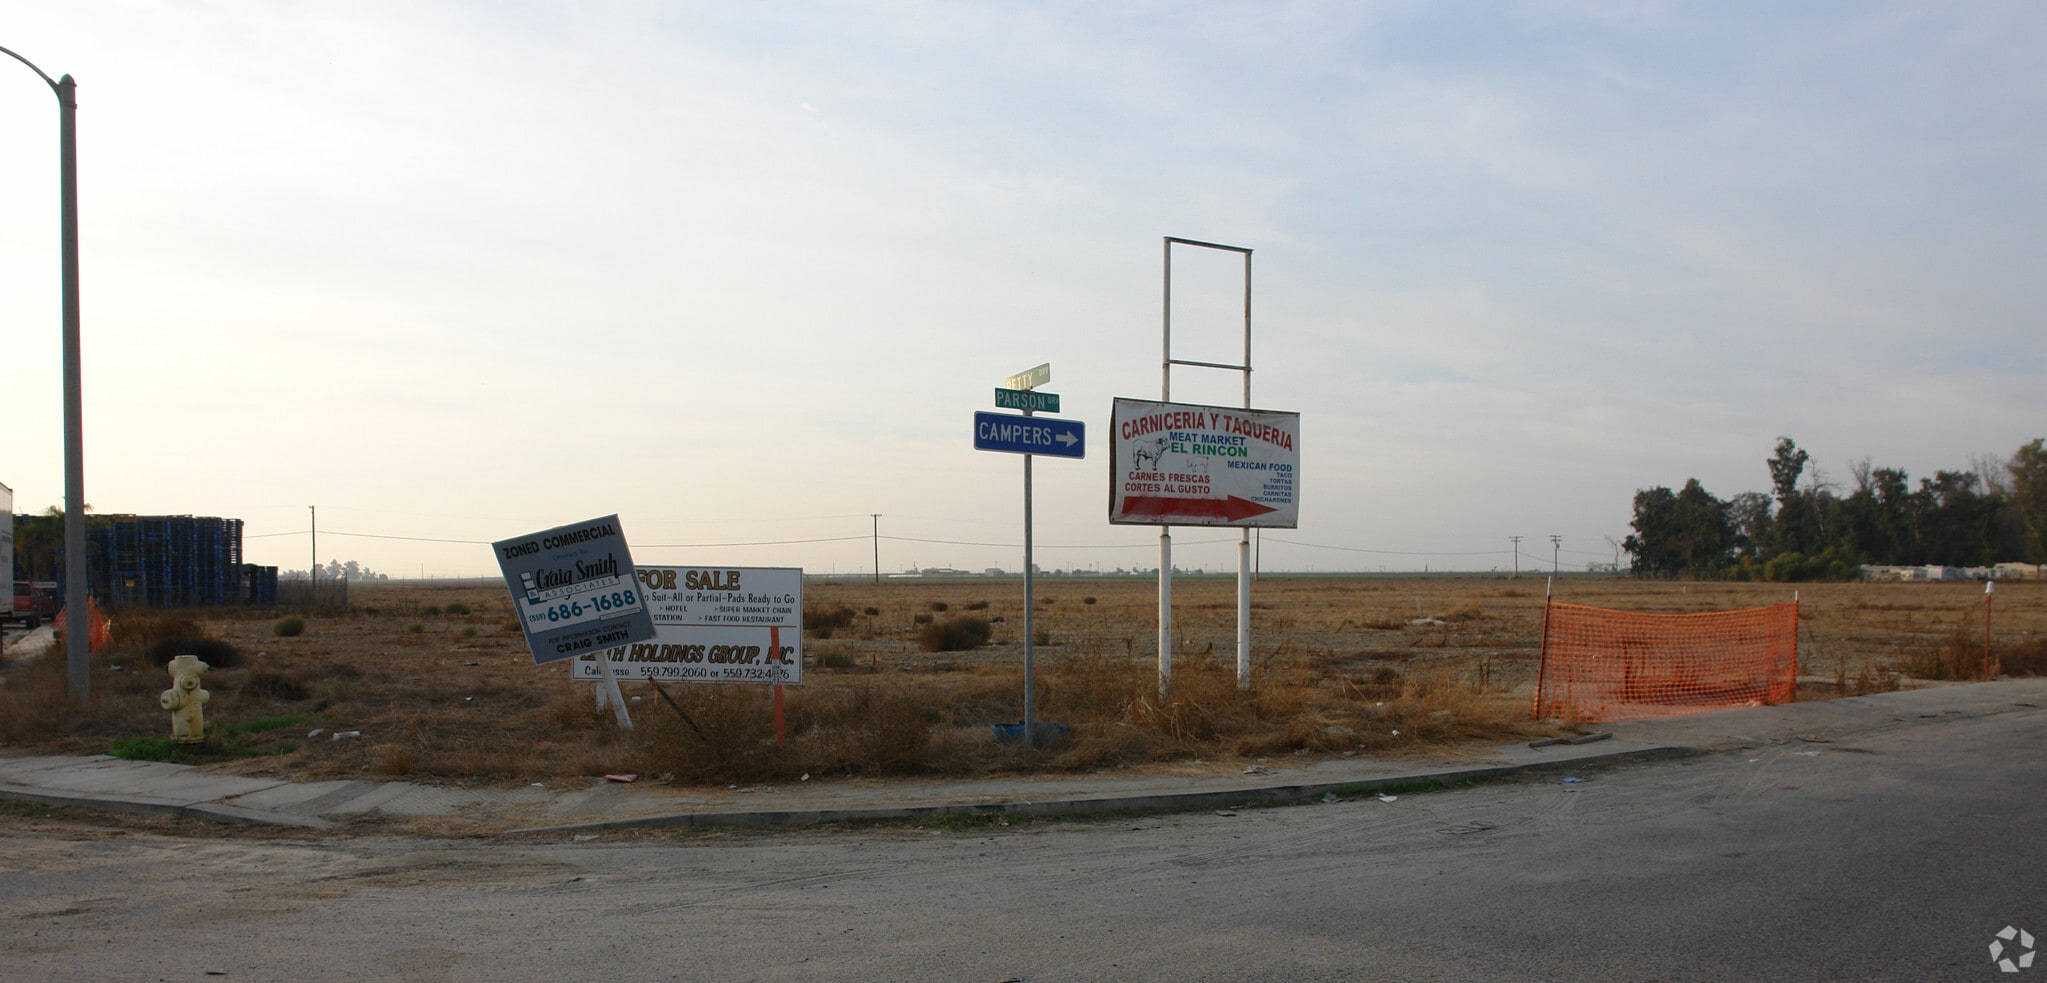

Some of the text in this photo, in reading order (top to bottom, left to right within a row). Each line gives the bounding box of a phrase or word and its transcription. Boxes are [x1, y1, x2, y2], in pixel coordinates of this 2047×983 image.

[997, 391, 1045, 409] PARSON
[980, 421, 1052, 446] CAMPERS
[1122, 411, 1293, 452] CARNICERIA Y TAQUERIA
[1169, 431, 1246, 446] MEAT MARKET
[1171, 442, 1248, 457] EL RINCON
[1227, 461, 1293, 472] MEXICAN FOOD
[1128, 471, 1210, 484] CARNES FRESCAS
[1125, 482, 1210, 495] CORTES AL GUSTO
[1263, 490, 1292, 498] CARNITAS
[503, 524, 616, 560] ZONED COMMERCIAL
[536, 553, 619, 590] Craig Smith
[636, 569, 741, 590] FOR SALE
[544, 578, 614, 598] ASSOCIATES
[547, 589, 636, 622] 686-1688
[748, 593, 772, 606] Ready
[773, 595, 781, 603] to
[784, 594, 795, 604] Go
[556, 638, 592, 653] CRAIG
[596, 630, 630, 645] SMITH
[562, 627, 601, 642] INFORMATION
[602, 621, 631, 633] CONTACT
[628, 643, 706, 664] HOLDINGS
[707, 645, 760, 666] GROUP,
[710, 670, 719, 678] or
[723, 668, 790, 679] 559.732.46
